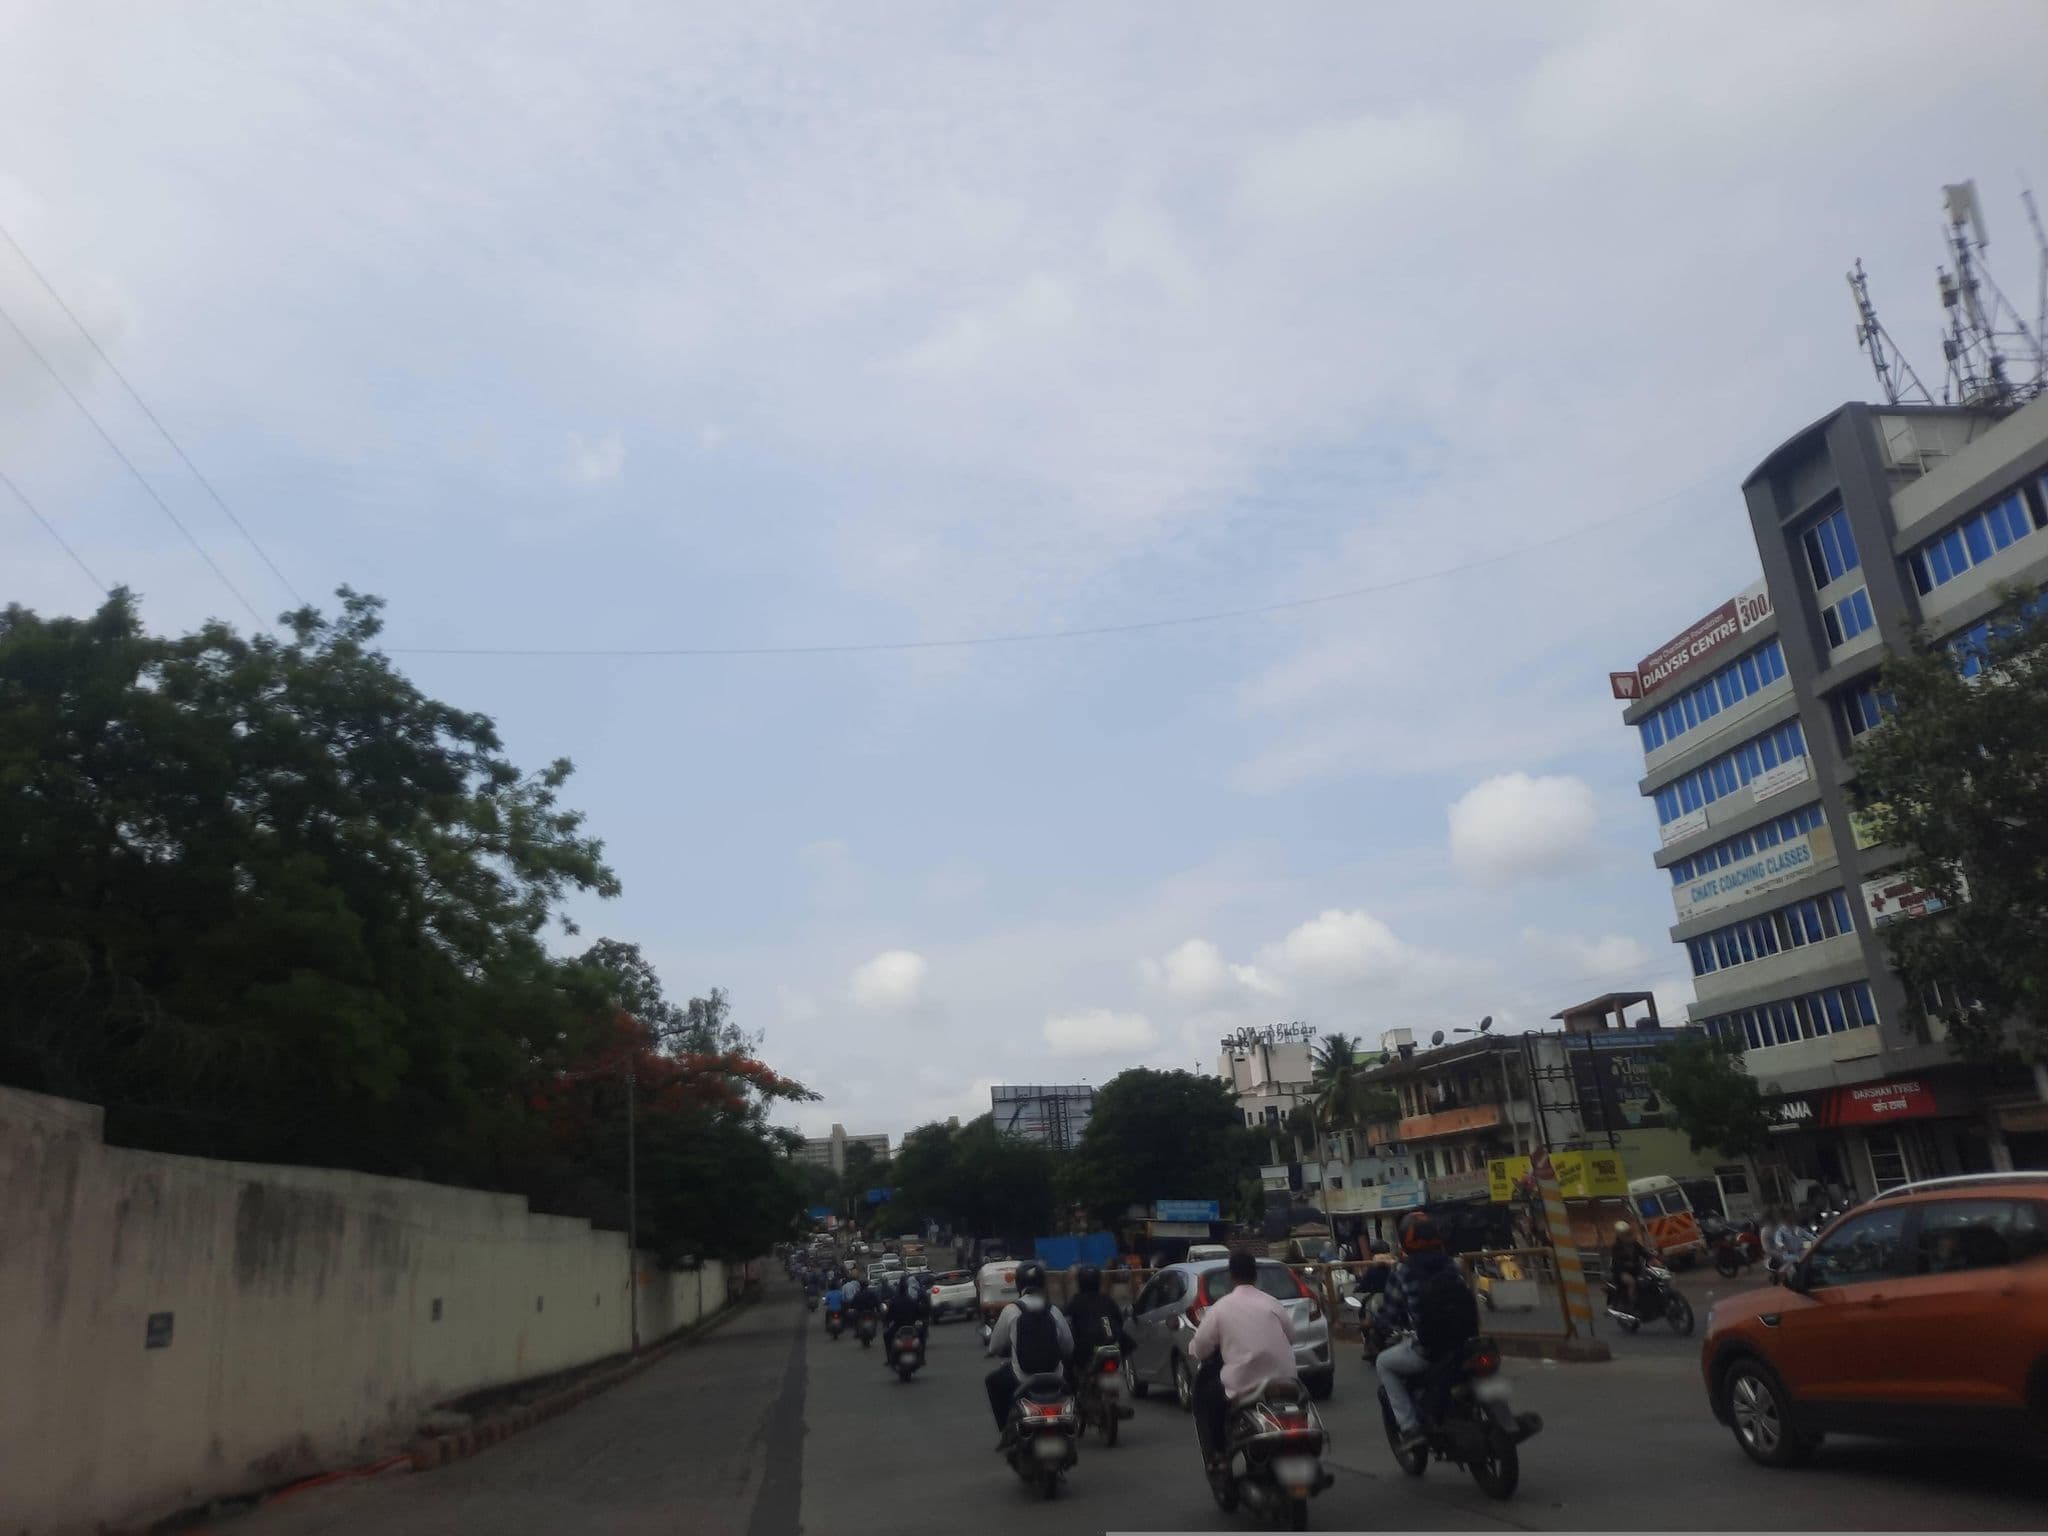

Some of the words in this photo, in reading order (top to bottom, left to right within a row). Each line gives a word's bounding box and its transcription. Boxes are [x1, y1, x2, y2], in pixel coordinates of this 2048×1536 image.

[1642, 649, 1690, 689] DIALYSIS
[1690, 617, 1738, 658] CENTRE
[1720, 863, 1766, 893] COACHING
[1766, 843, 1811, 876] CLASSES
[1852, 1084, 1892, 1101] DARSHAN
